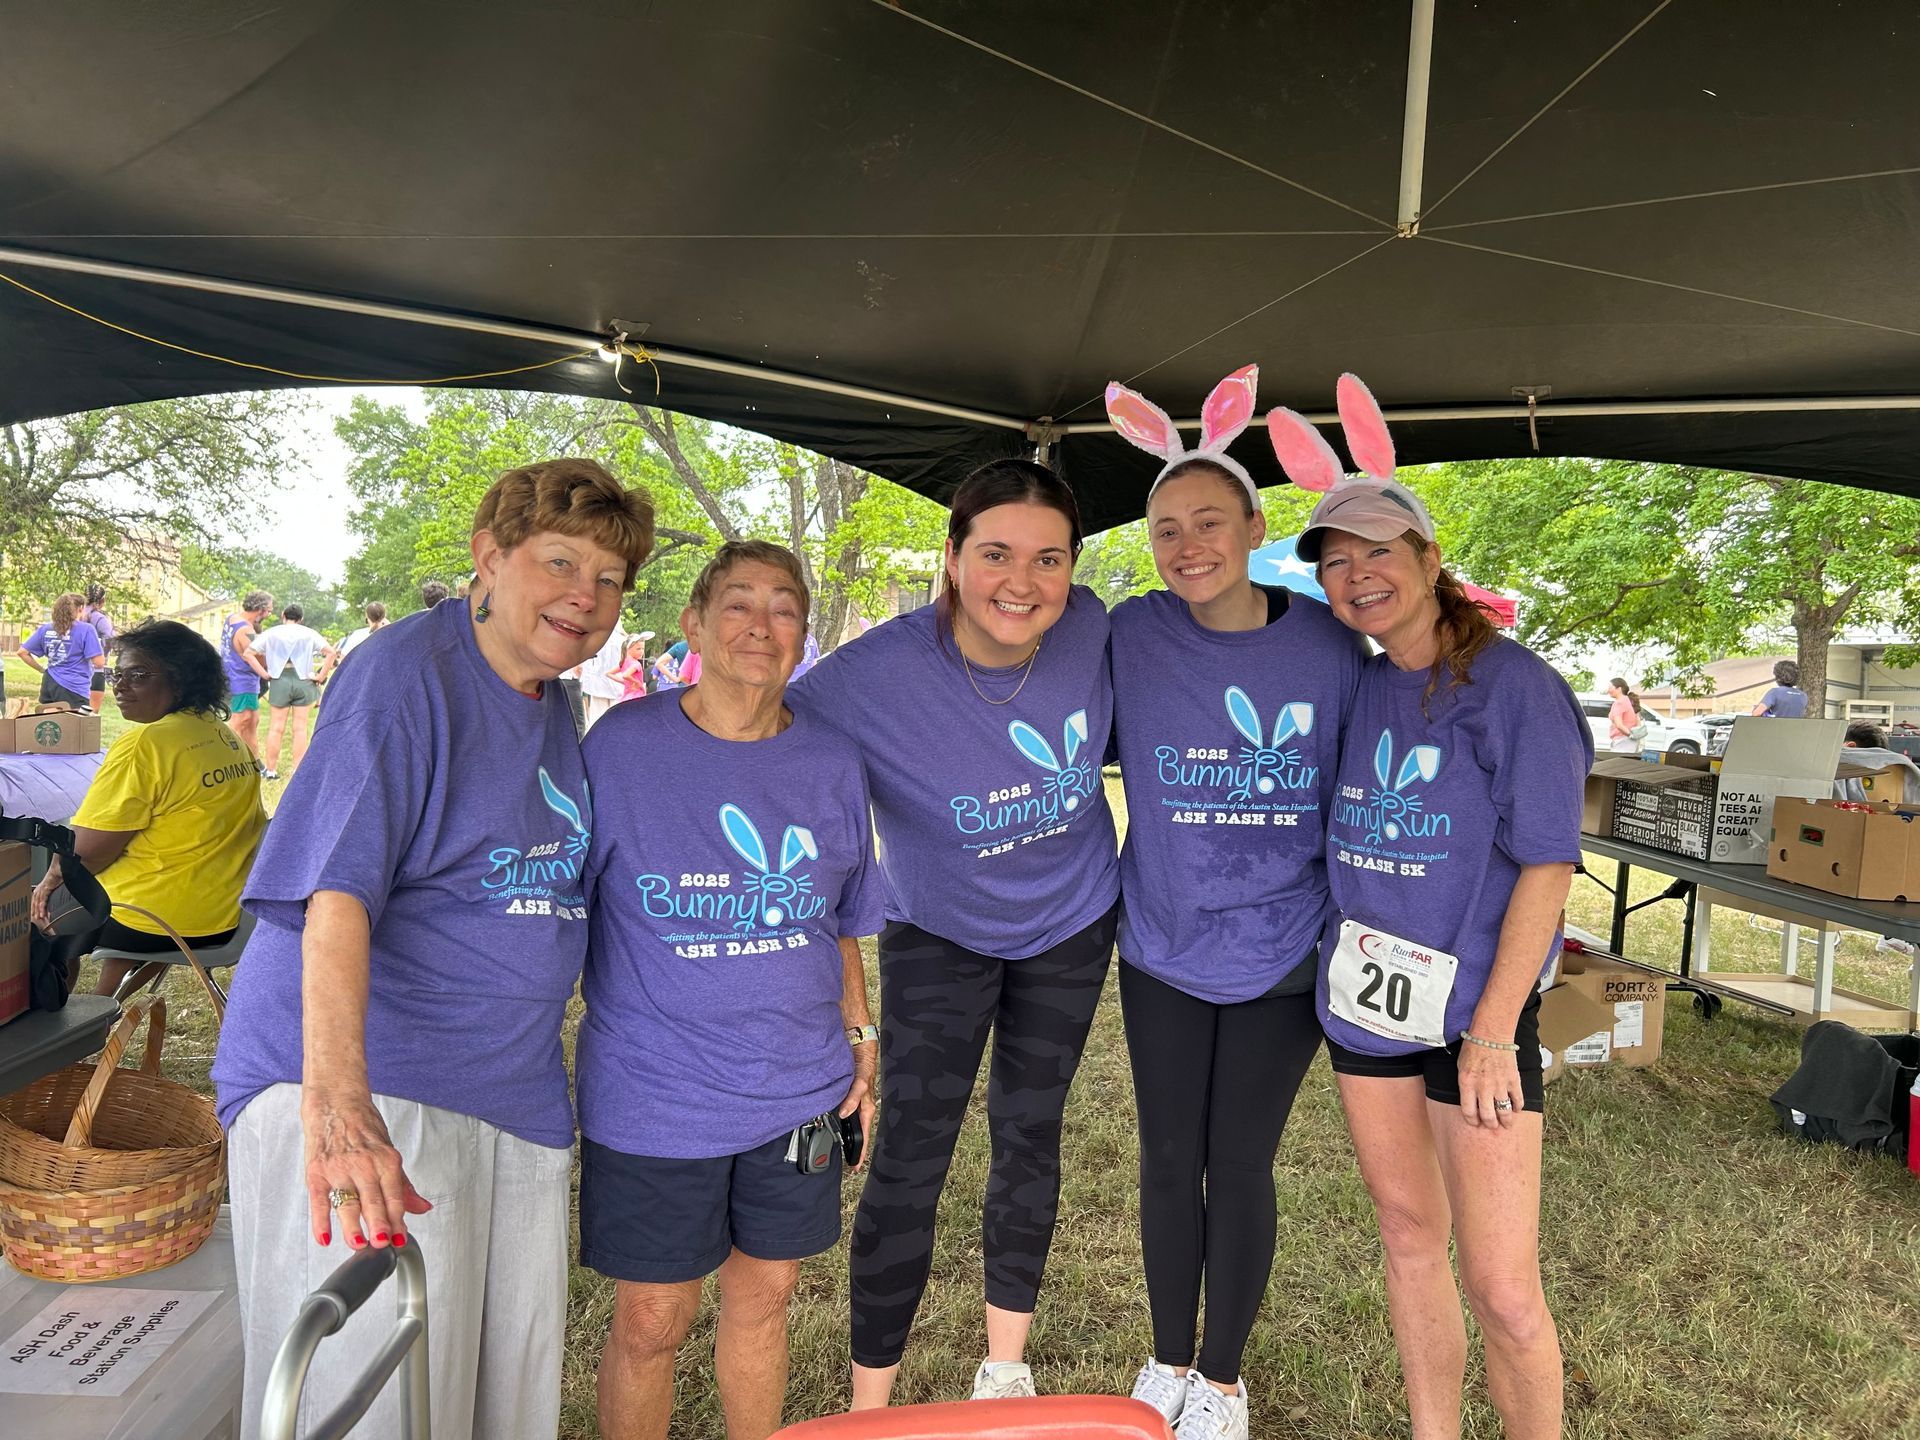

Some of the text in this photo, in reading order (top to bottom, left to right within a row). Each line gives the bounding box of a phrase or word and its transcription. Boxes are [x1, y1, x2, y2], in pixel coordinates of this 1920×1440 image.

[1186, 747, 1229, 761] 2025
[988, 783, 1032, 804] 2025
[1341, 785, 1364, 801] 2025
[1622, 790, 1636, 802] USA
[1720, 791, 1745, 802] NOT
[1191, 800, 1202, 809] the
[1203, 802, 1229, 811] patients
[1228, 801, 1238, 811] of
[1238, 802, 1248, 810] the
[1248, 802, 1271, 811] Austin
[1272, 803, 1289, 811] State
[1290, 802, 1320, 813] Hospital
[1620, 806, 1634, 816] FAST
[1632, 809, 1657, 821] FASHION
[1677, 799, 1703, 814] NEVER
[1719, 803, 1747, 814] TEES
[1171, 811, 1298, 826] ASH DASH 5K
[1677, 810, 1702, 823] TUBULAR
[1619, 823, 1655, 841] SUPERIOR
[1660, 821, 1677, 838] DTG
[1679, 821, 1699, 835] BLACK
[1716, 826, 1751, 837] EQUA
[977, 824, 1069, 858] ASH DASH
[1618, 832, 1633, 841] PRINT
[525, 841, 561, 859] 2025
[1398, 851, 1415, 860] State
[1416, 851, 1449, 863] Hospital
[1352, 854, 1395, 874] DASH
[1399, 863, 1426, 877] 5K
[679, 873, 731, 888] 2025
[533, 885, 547, 896] the
[505, 898, 552, 915] ASH
[696, 931, 709, 940] the
[709, 932, 741, 942] patients
[726, 938, 783, 956] DASH
[785, 932, 810, 949] 5K
[1391, 943, 1433, 965] RunFAR
[1356, 962, 1412, 1022] 20
[1605, 981, 1658, 993] PORT &
[1604, 993, 1657, 1002] COMPANY
[9, 1310, 81, 1364] ASH Dash
[48, 1321, 103, 1358] Food &
[68, 1315, 136, 1366] Beverage
[78, 1299, 180, 1385] Station Supplies
